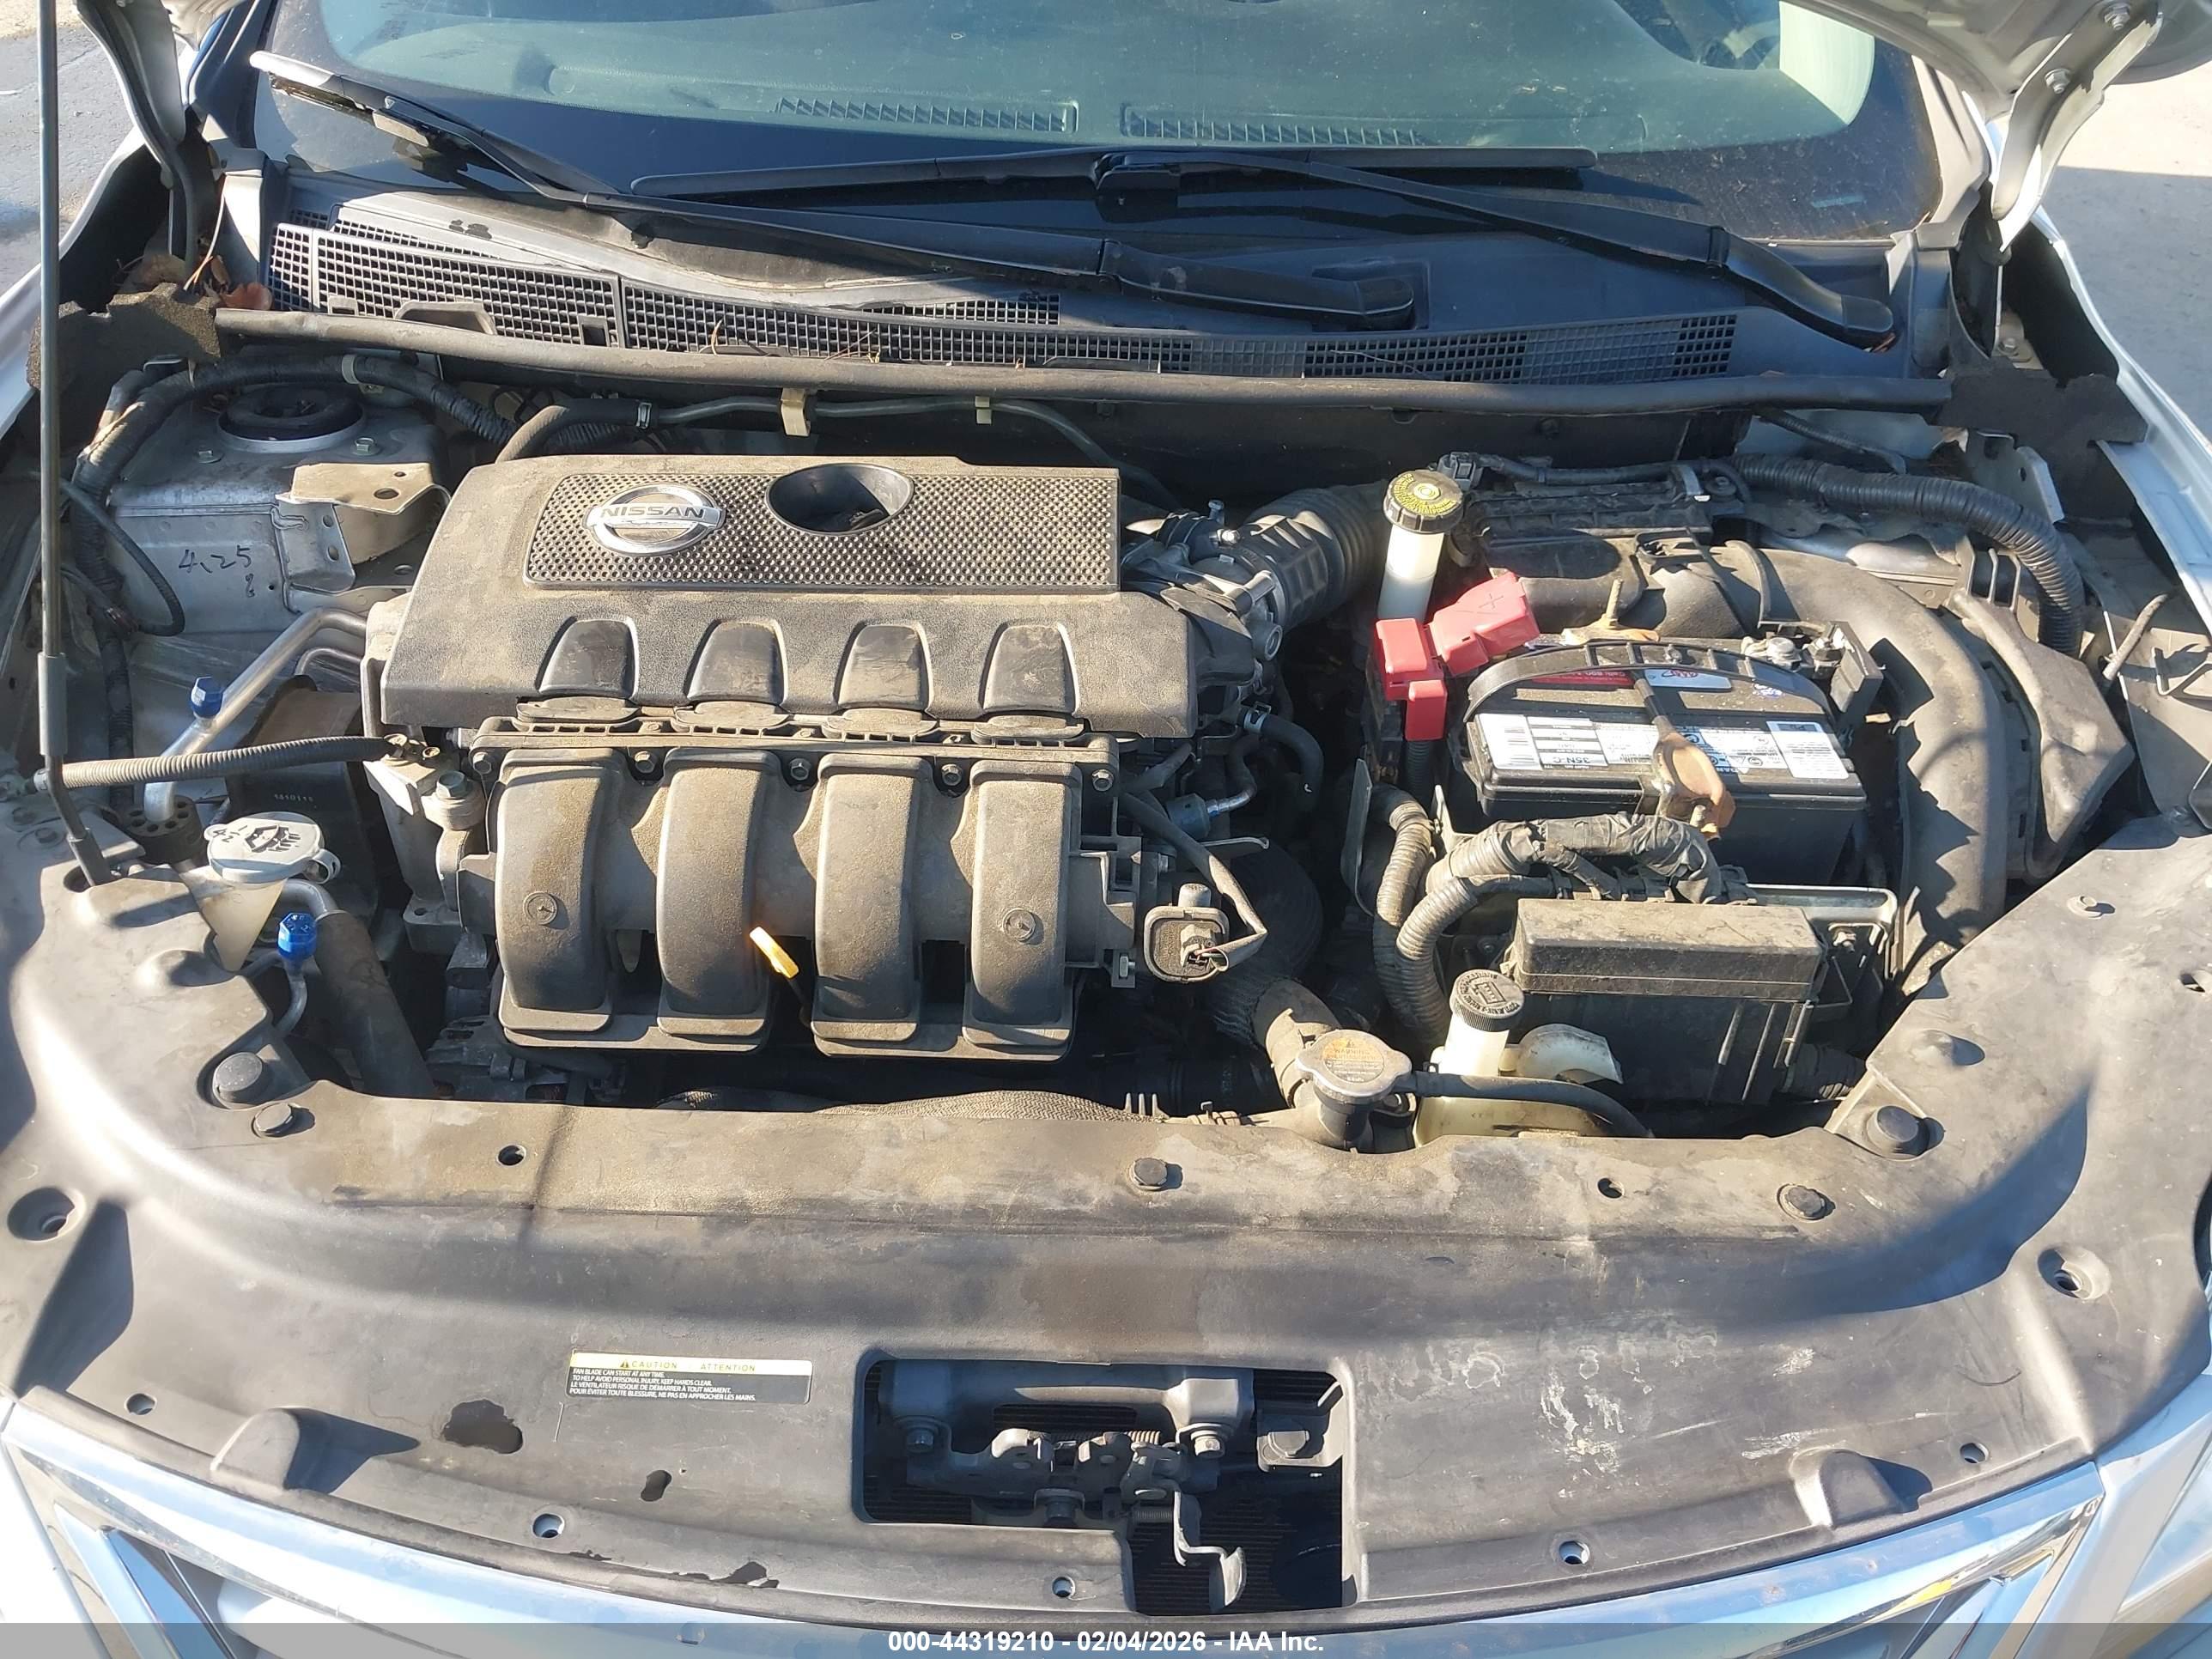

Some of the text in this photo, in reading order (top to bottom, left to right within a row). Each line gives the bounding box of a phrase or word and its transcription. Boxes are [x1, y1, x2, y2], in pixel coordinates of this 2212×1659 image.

[601, 507, 704, 519] NISSAN
[632, 1360, 756, 1372] CAUTION ATTENTION
